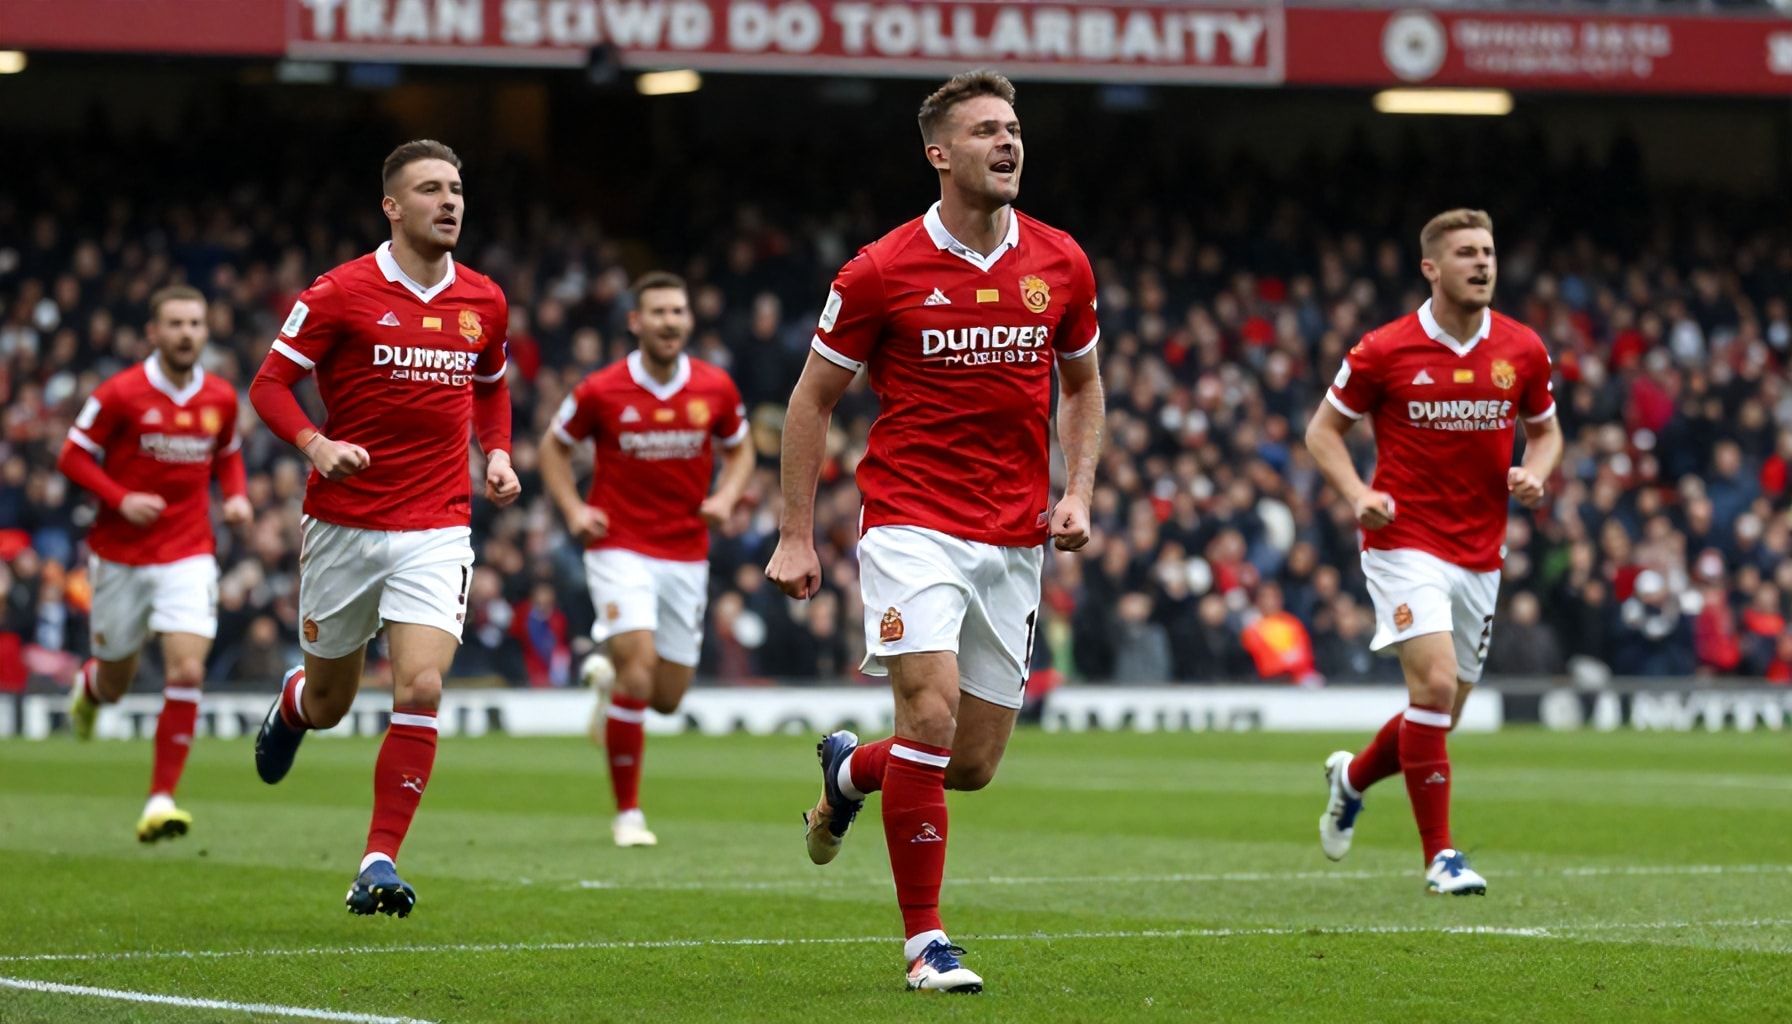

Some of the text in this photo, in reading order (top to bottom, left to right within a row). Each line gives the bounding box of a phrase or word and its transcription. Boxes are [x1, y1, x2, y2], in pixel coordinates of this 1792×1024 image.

[304, 0, 484, 42] TRAN
[728, 1, 822, 54] DO
[834, 5, 1264, 64] TOLLARBAITY
